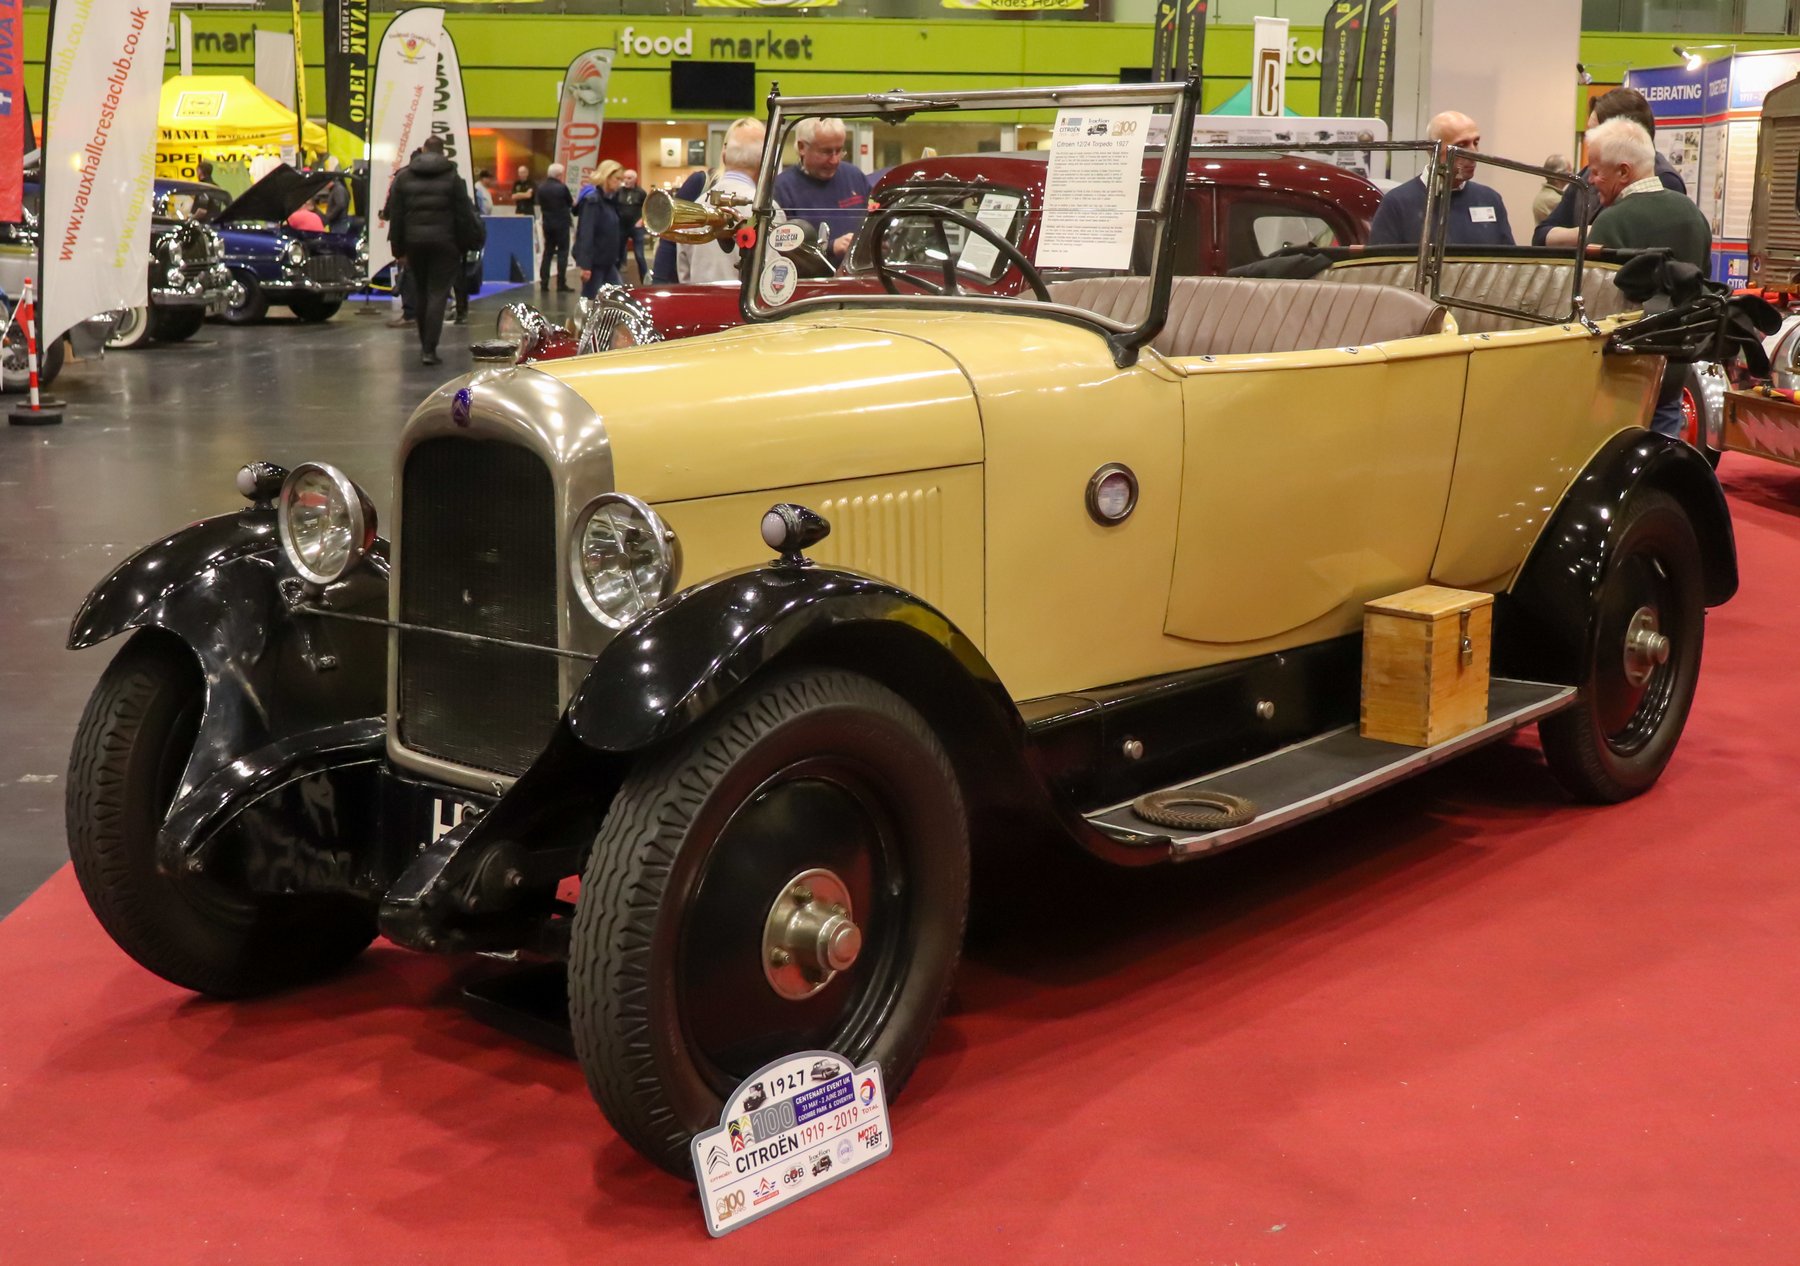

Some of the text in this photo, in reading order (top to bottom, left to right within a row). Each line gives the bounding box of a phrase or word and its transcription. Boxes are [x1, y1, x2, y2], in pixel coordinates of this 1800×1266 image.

[620, 26, 813, 60] food market
[59, 7, 149, 262] www.vauxhallcrestaclub.co.uk
[162, 129, 209, 140] MANTA
[770, 1070, 805, 1097] 1927
[795, 1076, 851, 1104] CENTENARY EVENT UK
[808, 1100, 818, 1109] MAY
[826, 1092, 837, 1101] JUNE
[837, 1087, 848, 1097] 2019
[816, 1105, 827, 1114] PARK
[833, 1093, 854, 1107] COVENTRY
[862, 1104, 879, 1114] TOTAL
[752, 1101, 795, 1140] 100
[736, 1133, 798, 1173] CITROËN
[800, 1122, 824, 1145] 1919
[834, 1106, 858, 1131] 2019
[857, 1124, 878, 1142] MOTO
[865, 1131, 883, 1148] FEST
[724, 1189, 745, 1213] 100
